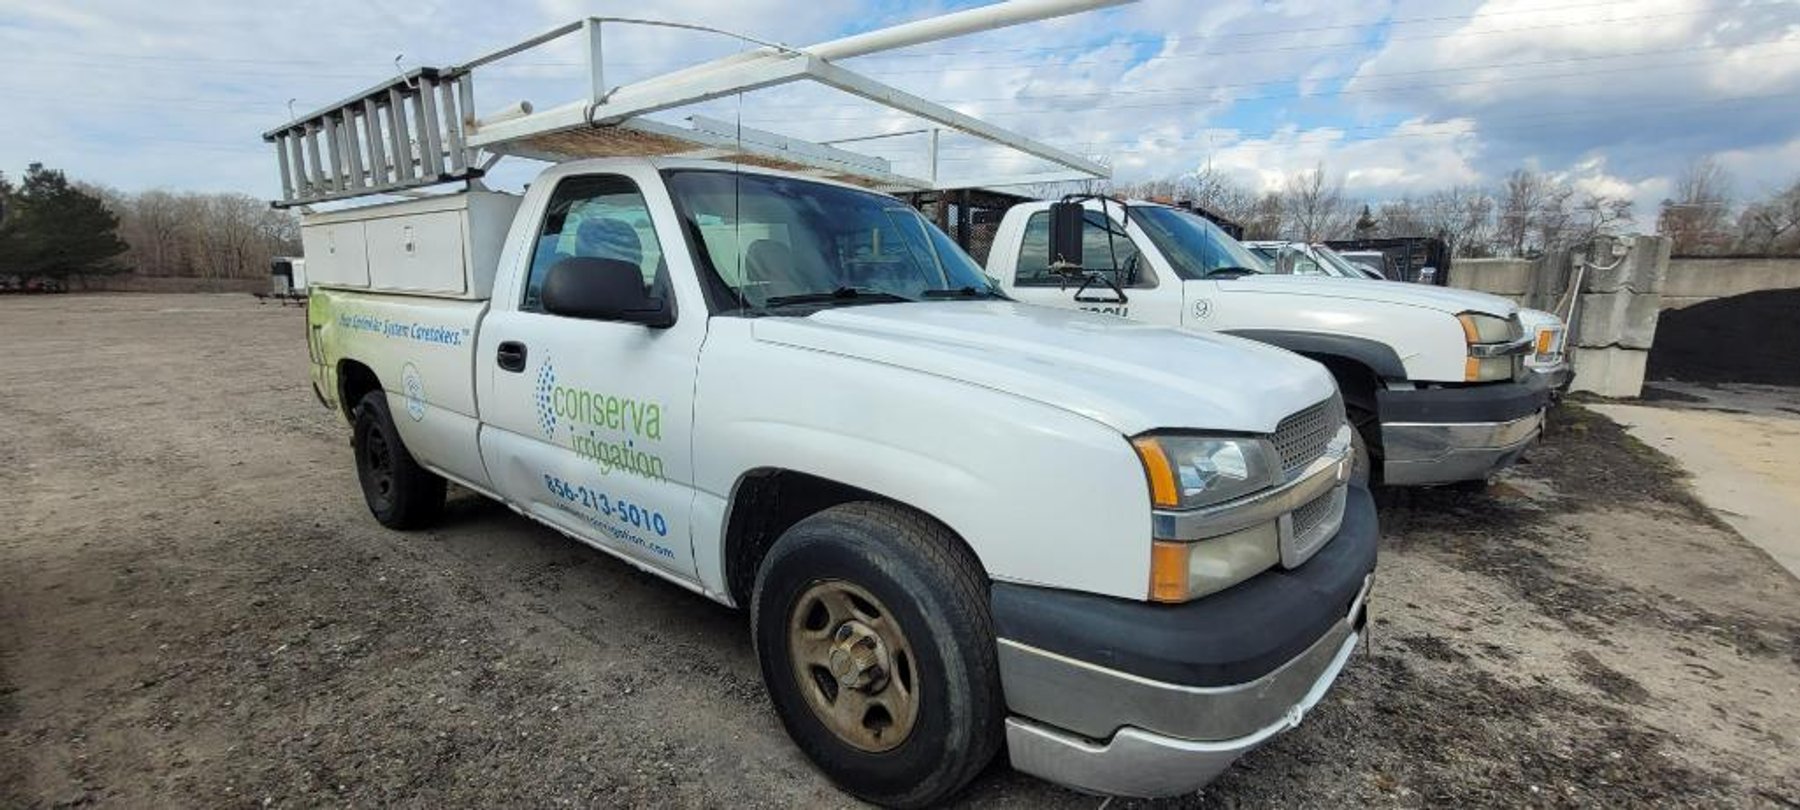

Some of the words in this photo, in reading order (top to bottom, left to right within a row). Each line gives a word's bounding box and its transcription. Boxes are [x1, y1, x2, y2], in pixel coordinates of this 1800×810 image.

[553, 386, 661, 441] conserva
[570, 425, 667, 484] irrigation
[544, 474, 667, 536] 856-213-5010
